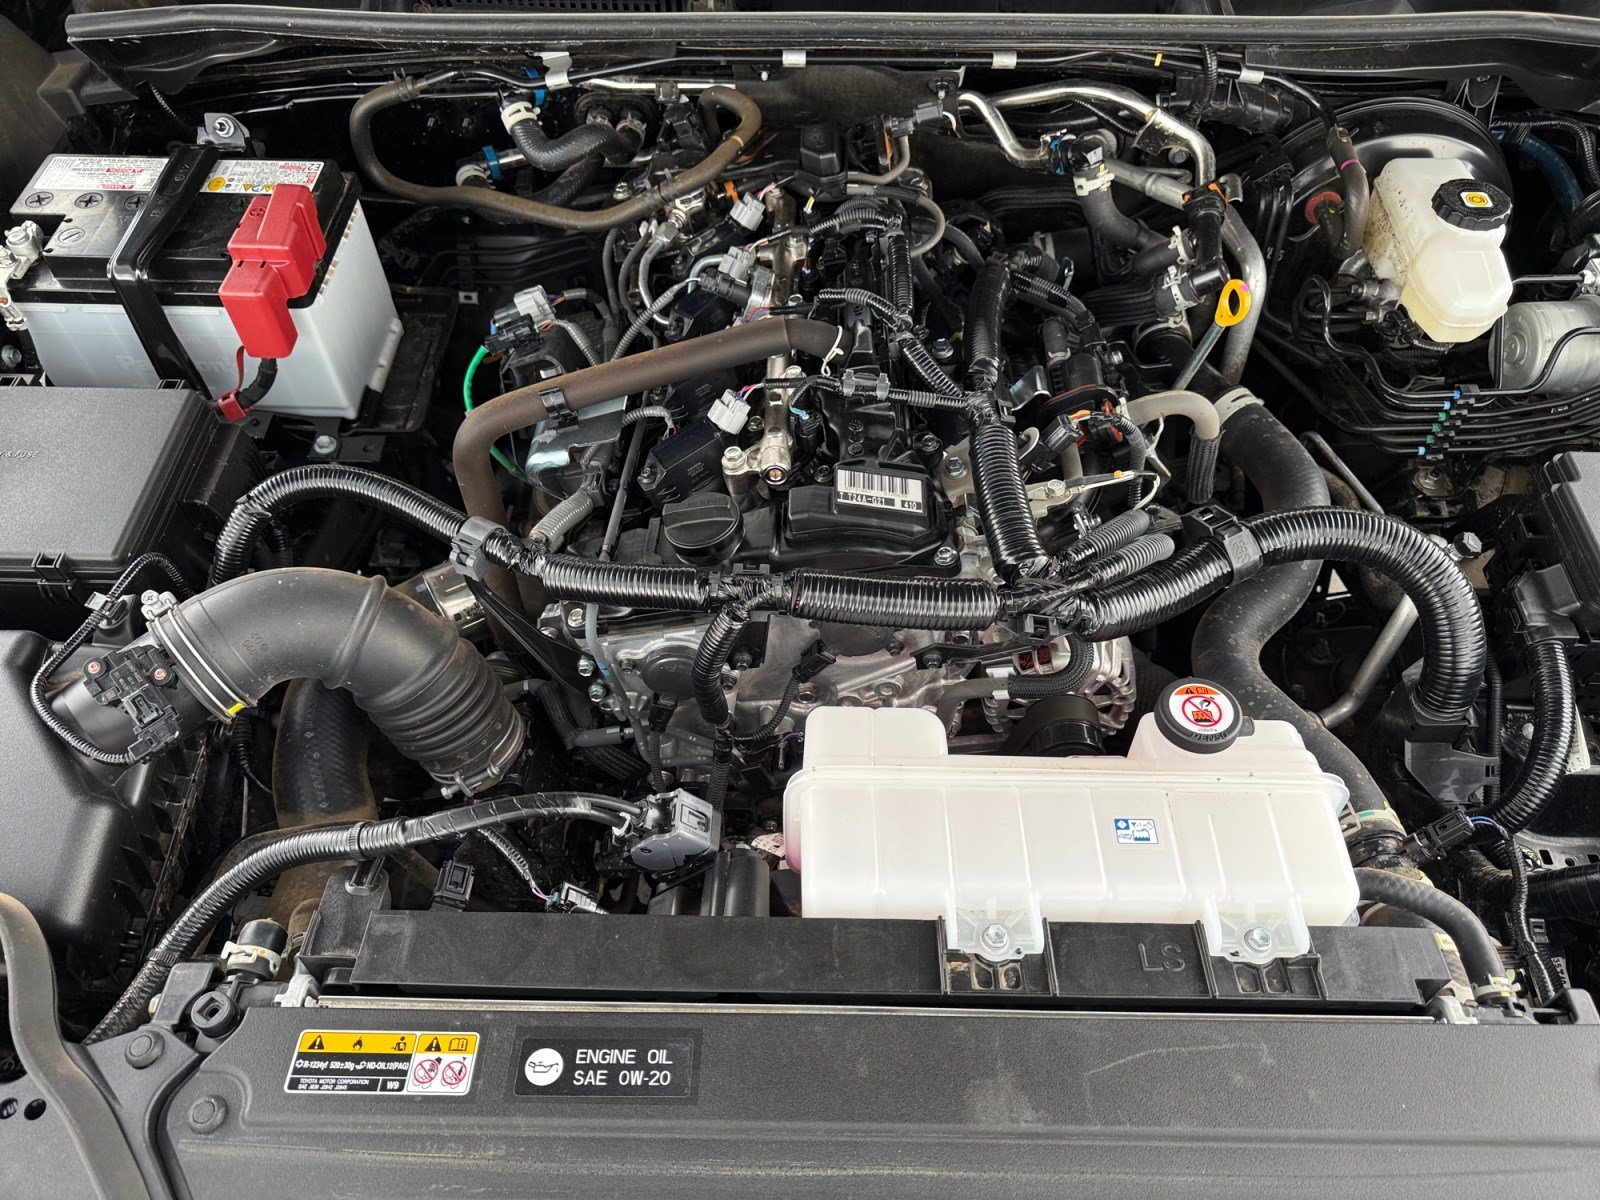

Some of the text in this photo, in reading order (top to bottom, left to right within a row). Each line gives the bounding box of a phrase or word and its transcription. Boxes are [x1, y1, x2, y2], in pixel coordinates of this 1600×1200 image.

[904, 501, 917, 511] 410
[1138, 942, 1186, 972] LS
[575, 1049, 673, 1064] ENGINE OIL
[303, 1060, 329, 1070] R-1234yf
[573, 1070, 671, 1086] SAE 0W-20
[386, 1081, 400, 1090] W9
